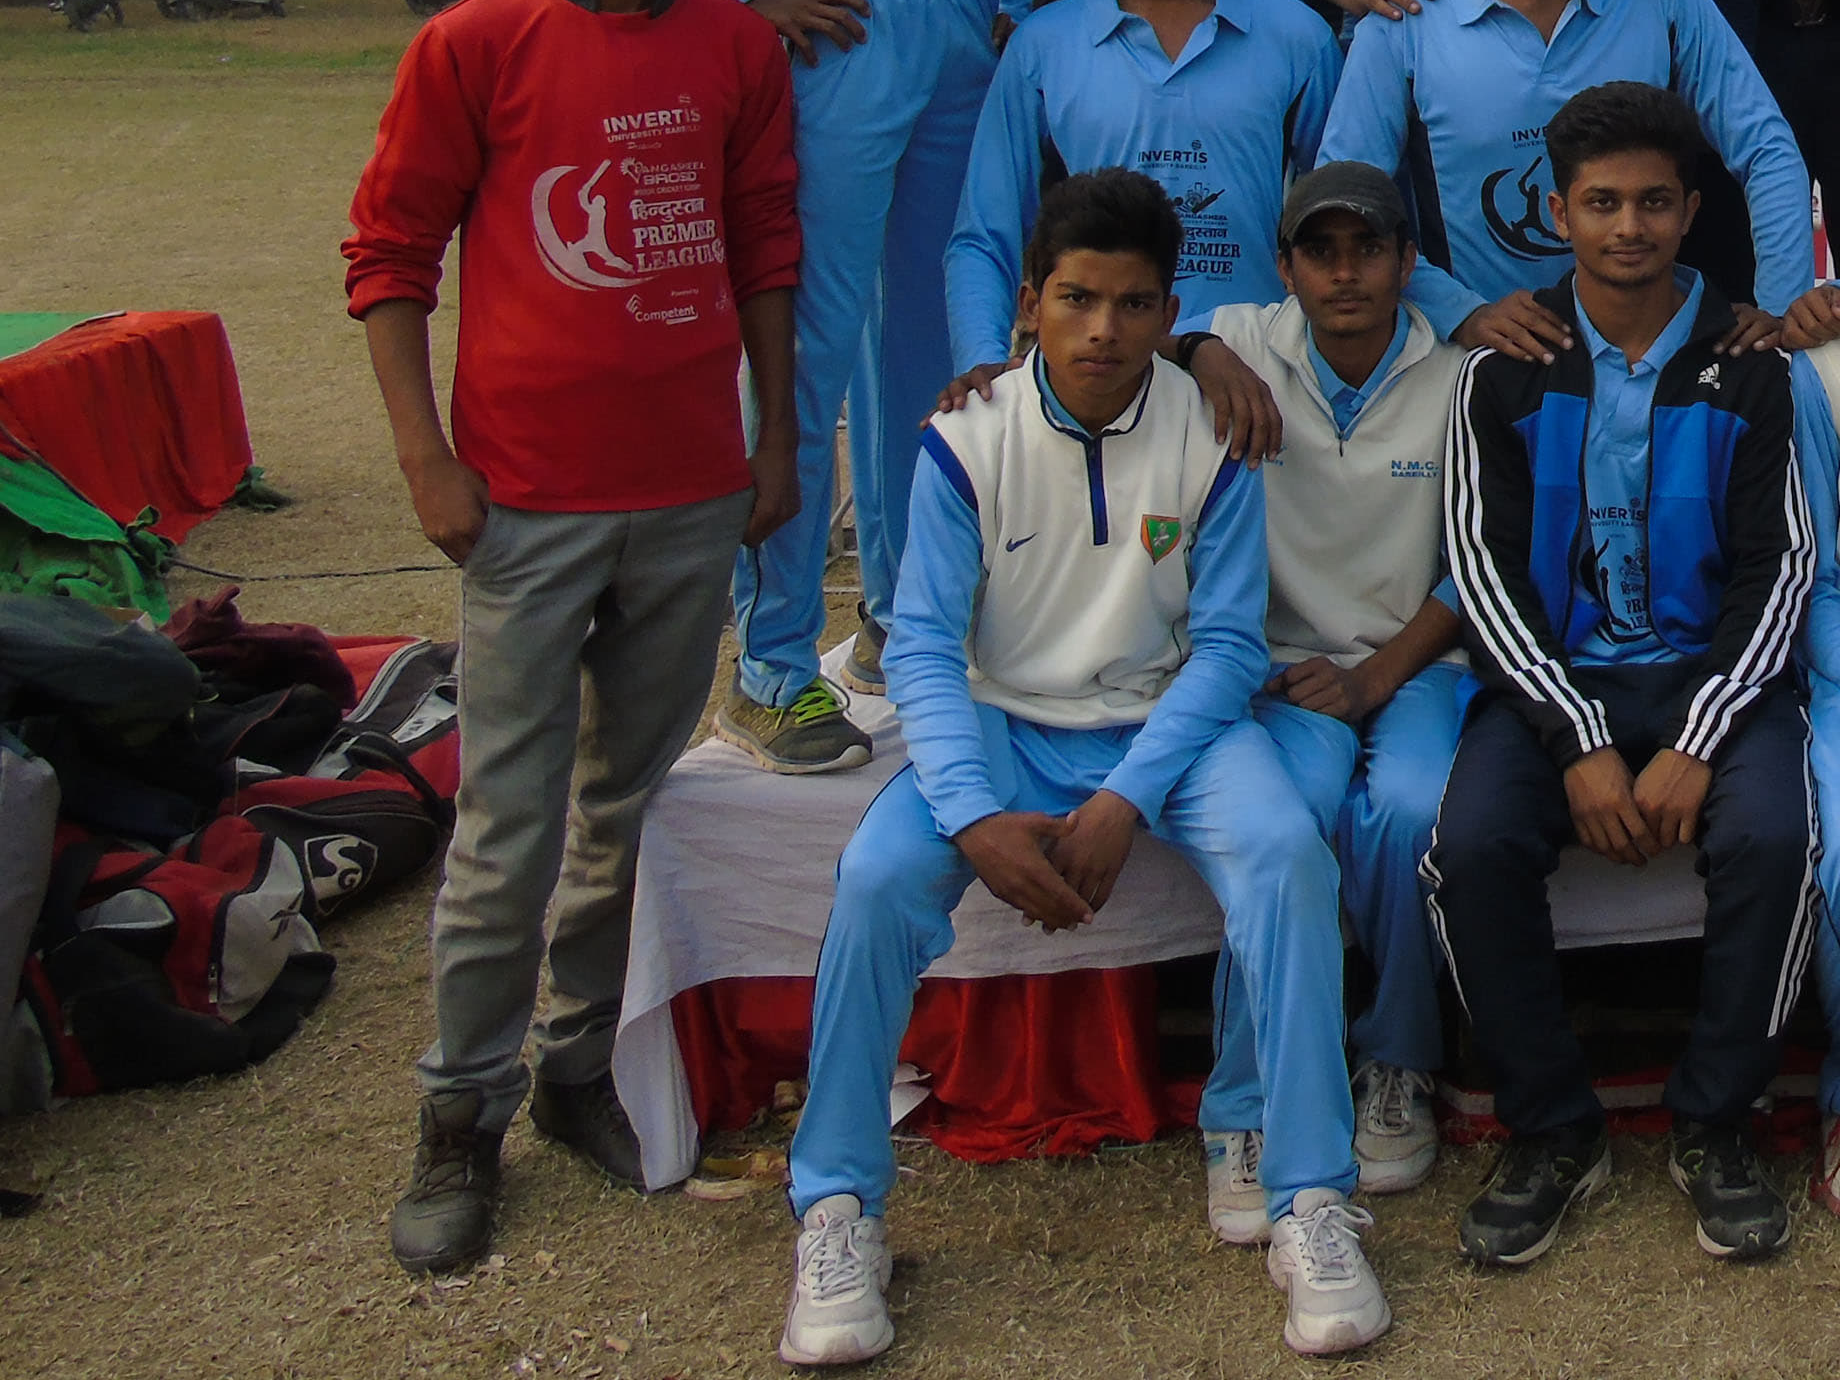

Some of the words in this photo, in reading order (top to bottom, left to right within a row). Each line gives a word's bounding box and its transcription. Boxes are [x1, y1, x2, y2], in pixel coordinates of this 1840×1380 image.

[603, 108, 700, 133] INVERTIS
[608, 129, 662, 143] UNIVERSITY
[1138, 150, 1208, 163] INVERTIS
[1179, 242, 1240, 258] REMIER
[1176, 259, 1232, 274] EAGUE
[635, 304, 695, 322] Competent
[1391, 460, 1439, 470] N.M.C.
[1391, 470, 1437, 478] BAREILLY
